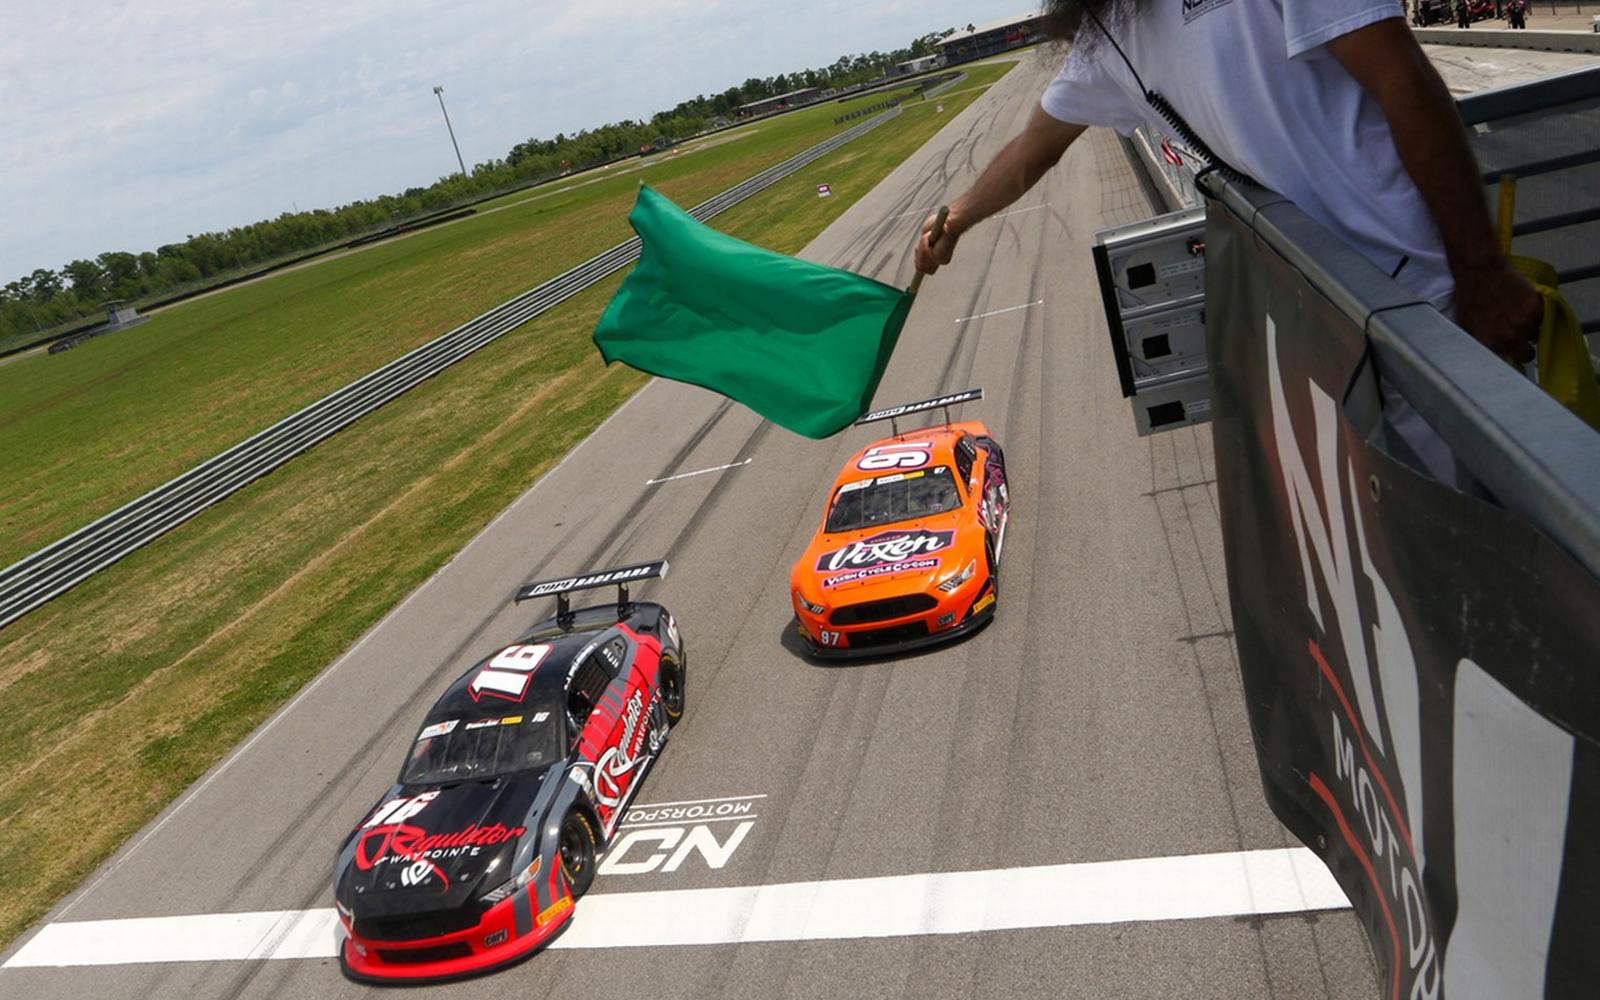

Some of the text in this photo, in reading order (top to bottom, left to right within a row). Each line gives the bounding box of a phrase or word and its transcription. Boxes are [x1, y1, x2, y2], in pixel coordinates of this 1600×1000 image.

[828, 534, 944, 571] Vixen
[468, 642, 553, 701] 16
[362, 790, 441, 828] 16
[624, 802, 752, 822] MOTORSPO
[355, 822, 527, 873] Regulator
[389, 845, 481, 865] WAYPOINTE
